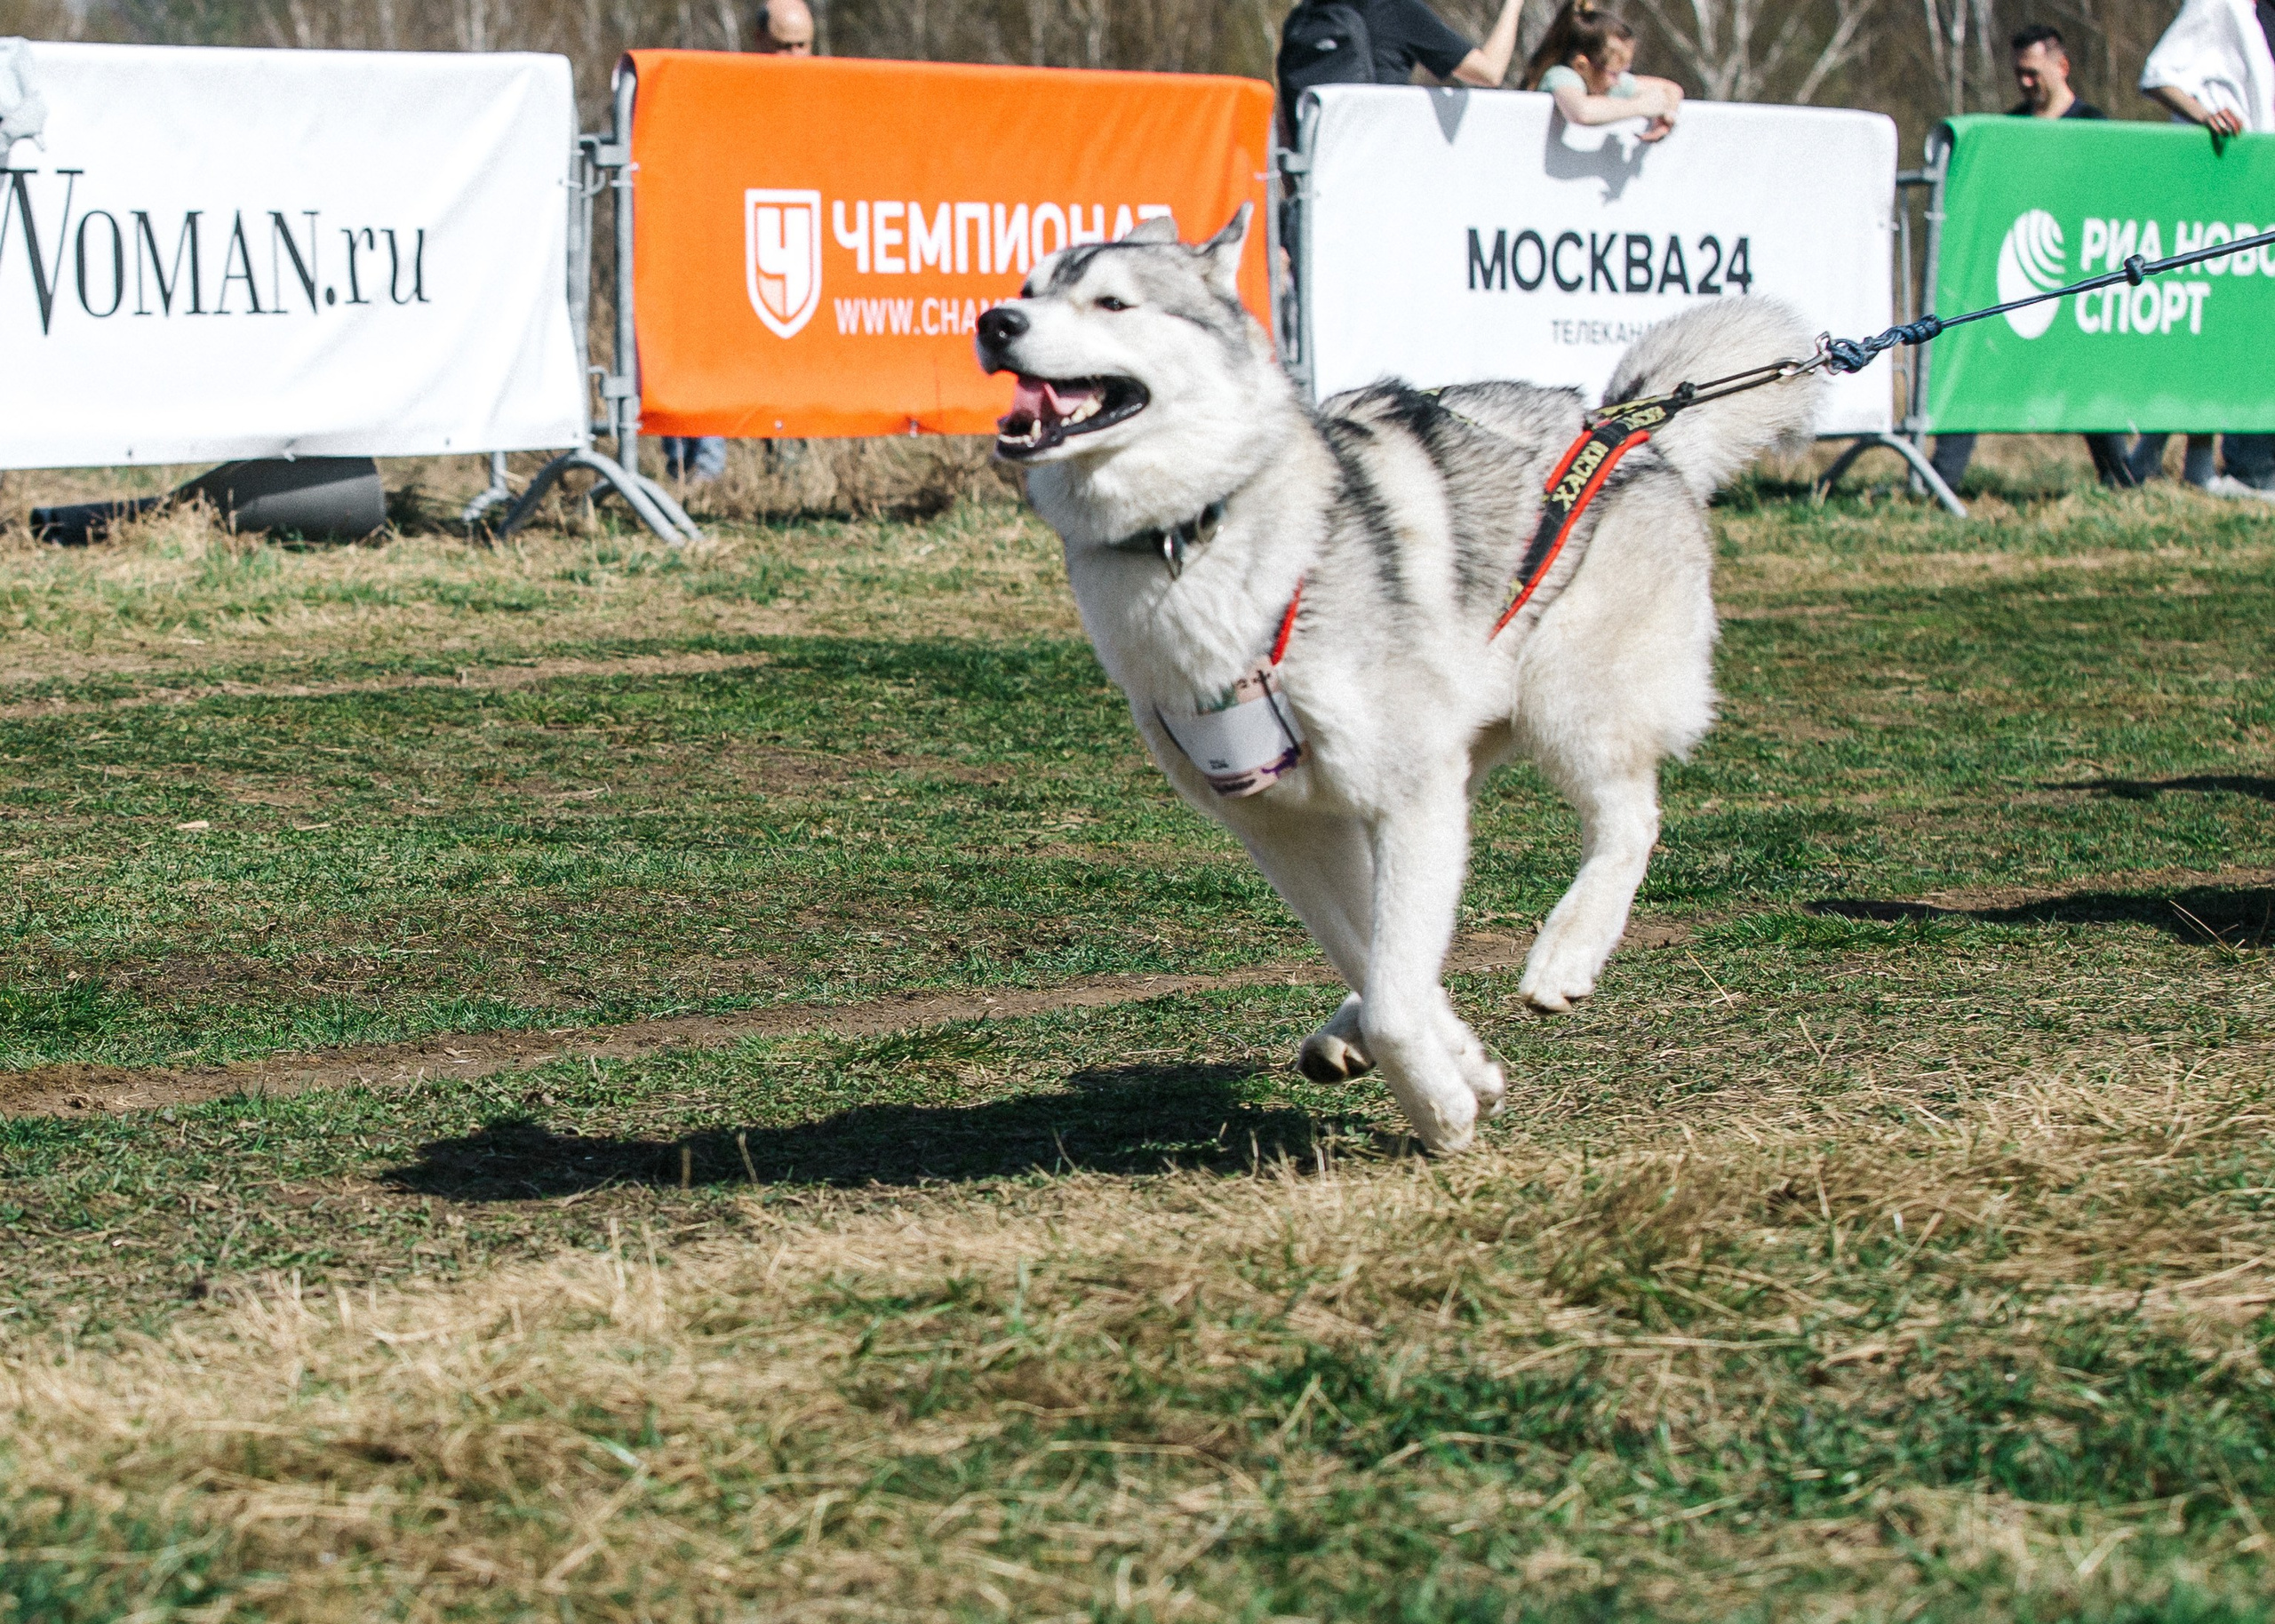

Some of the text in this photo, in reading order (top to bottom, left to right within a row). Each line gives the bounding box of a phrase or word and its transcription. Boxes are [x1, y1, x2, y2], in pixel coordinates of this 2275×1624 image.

[832, 199, 1172, 275] ЧЕМПИОН
[1467, 227, 1752, 294] МОСКВА24
[2080, 217, 2162, 272] РИА
[834, 297, 1020, 335] WWW.CHA
[1552, 320, 1653, 345] ТЕЛЕКАН
[2075, 280, 2211, 335] СПОРТ
